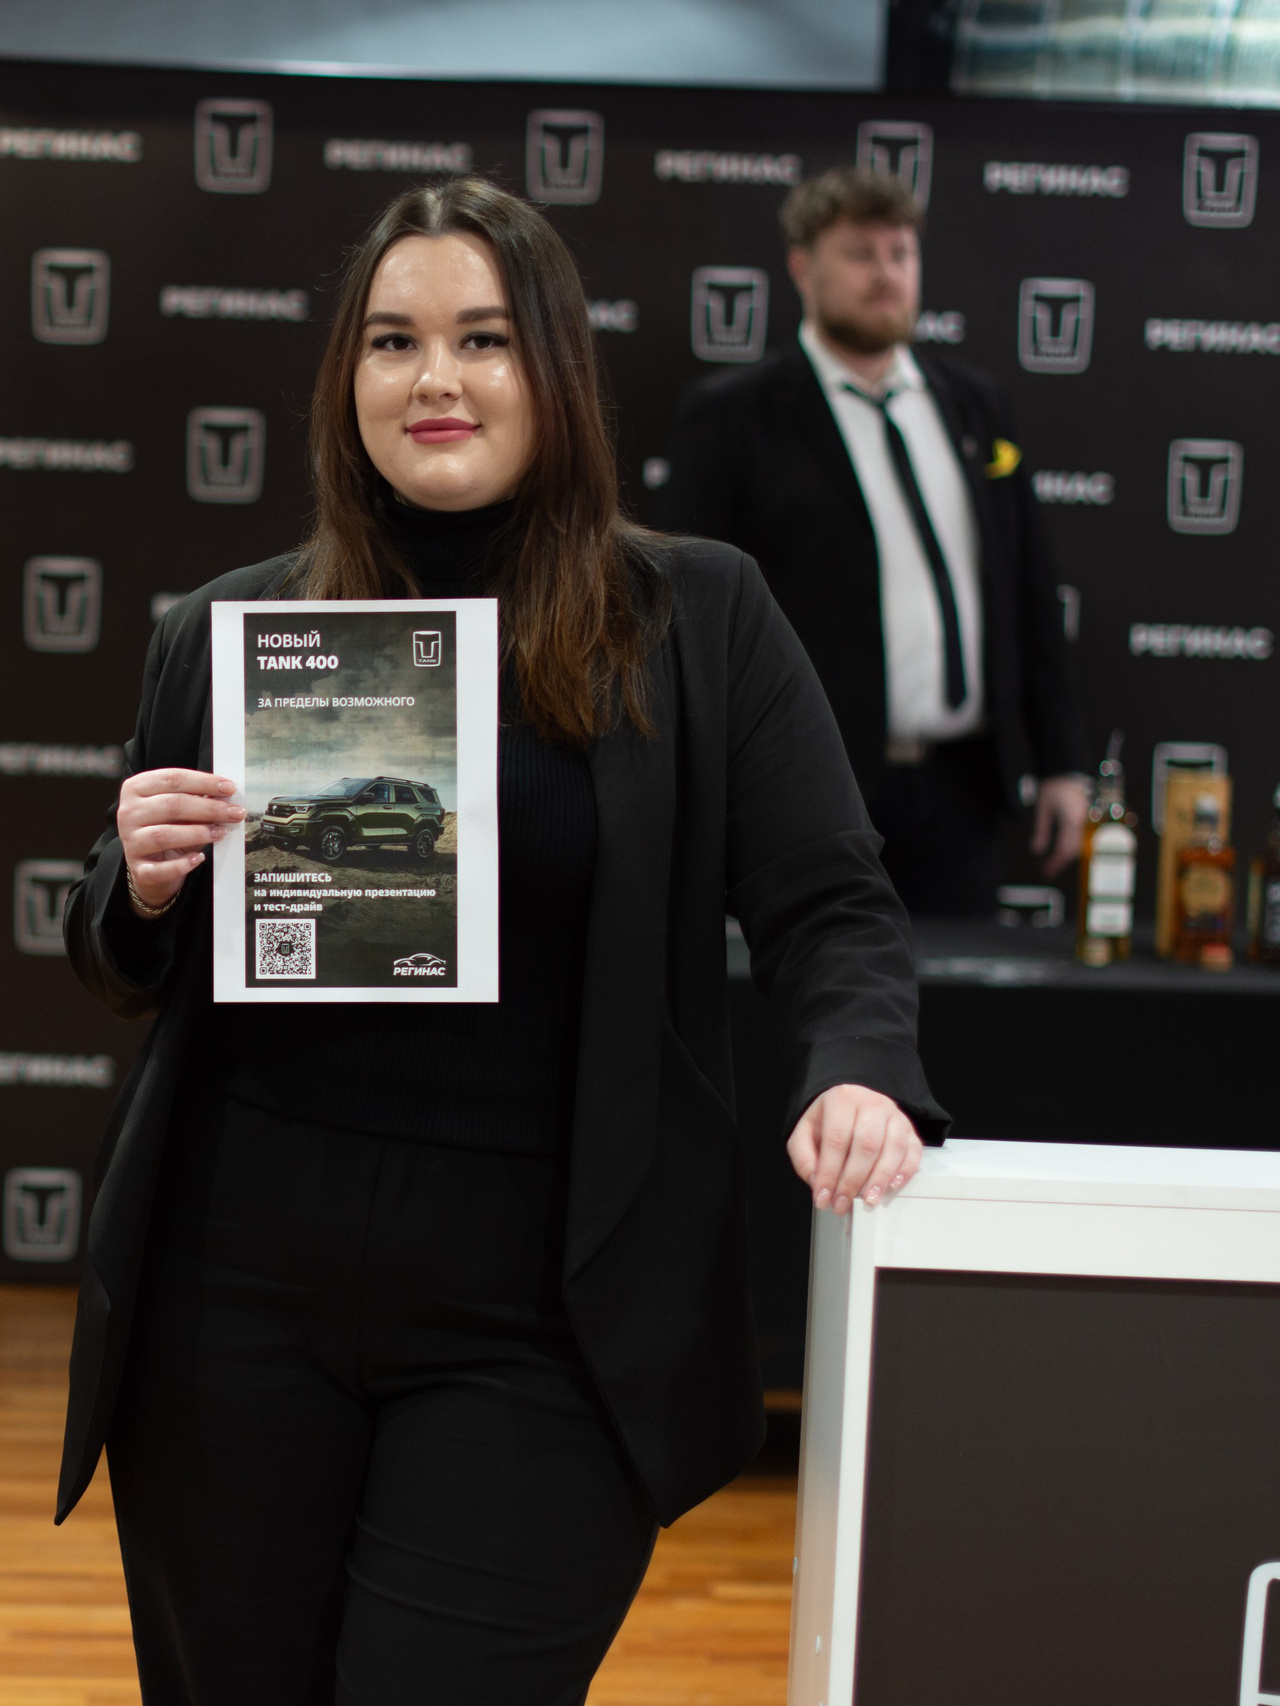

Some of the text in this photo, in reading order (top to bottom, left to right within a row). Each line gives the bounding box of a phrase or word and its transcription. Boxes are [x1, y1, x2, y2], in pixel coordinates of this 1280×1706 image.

[984, 162, 1129, 197] РЕГИНАС
[257, 630, 321, 648] НОВЫЙ
[1130, 624, 1273, 659] РЕГИНАС
[256, 655, 339, 670] TANK 400
[257, 696, 415, 709] ЗА ПРЕДЕЛЫ ВОЗМОЖНОГО
[253, 873, 332, 883] ЗАПИШИТЕСЬ
[253, 889, 436, 899] на индивидуальную презентацию
[253, 901, 323, 913] и тест-драйв
[393, 967, 446, 976] РЕГИНАС
